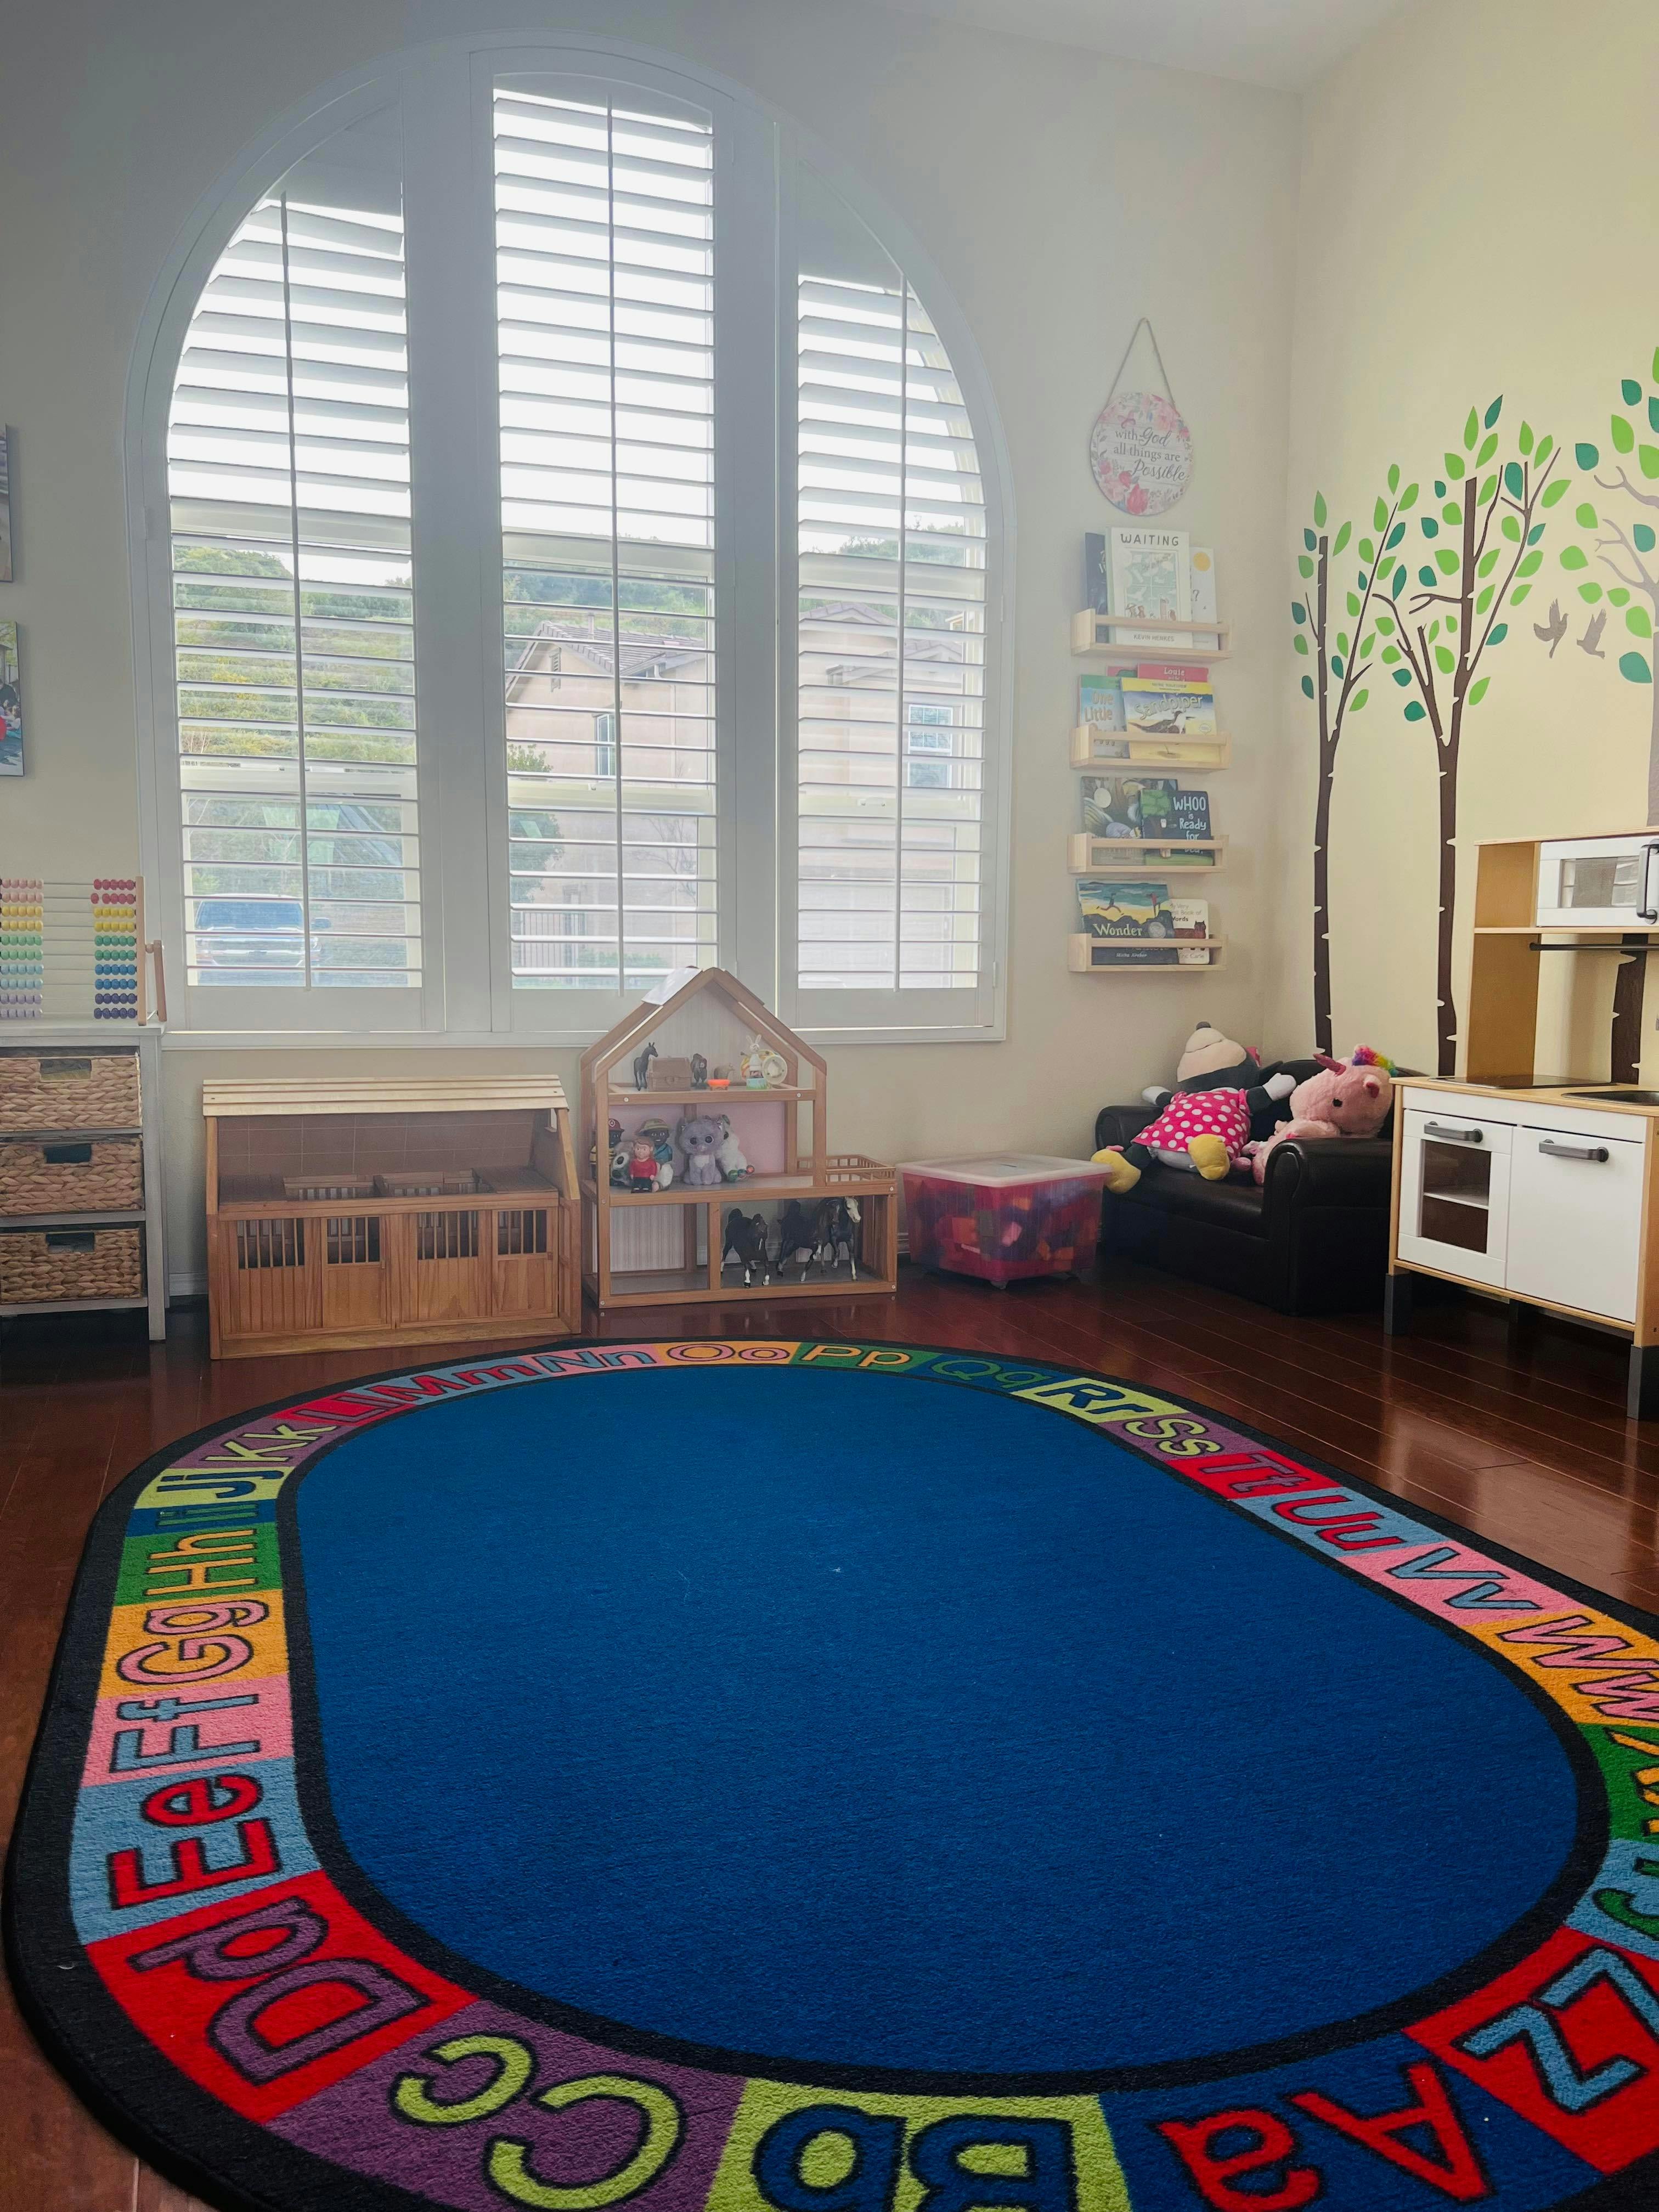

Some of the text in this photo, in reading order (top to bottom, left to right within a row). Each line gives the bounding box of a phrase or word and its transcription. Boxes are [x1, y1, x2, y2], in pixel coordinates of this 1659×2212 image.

[1115, 427, 1172, 447] with God
[1114, 442, 1181, 462] all things are
[1132, 459, 1186, 482] Possible
[1120, 533, 1179, 546] WAITING
[1084, 704, 1113, 722] Little
[1134, 693, 1203, 720] Sandpiper
[1172, 795, 1206, 811] WHOO
[1179, 817, 1206, 831] Ready
[1188, 811, 1194, 820] is
[1186, 830, 1200, 840] for
[1092, 923, 1143, 936] Wonder
[144, 1528, 257, 1596] Hh
[117, 1599, 269, 1685] Gg
[109, 1692, 261, 1774] Ff
[105, 1771, 281, 1911] Ee
[126, 1895, 433, 2085] Dd
[387, 2031, 687, 2211] Cc
